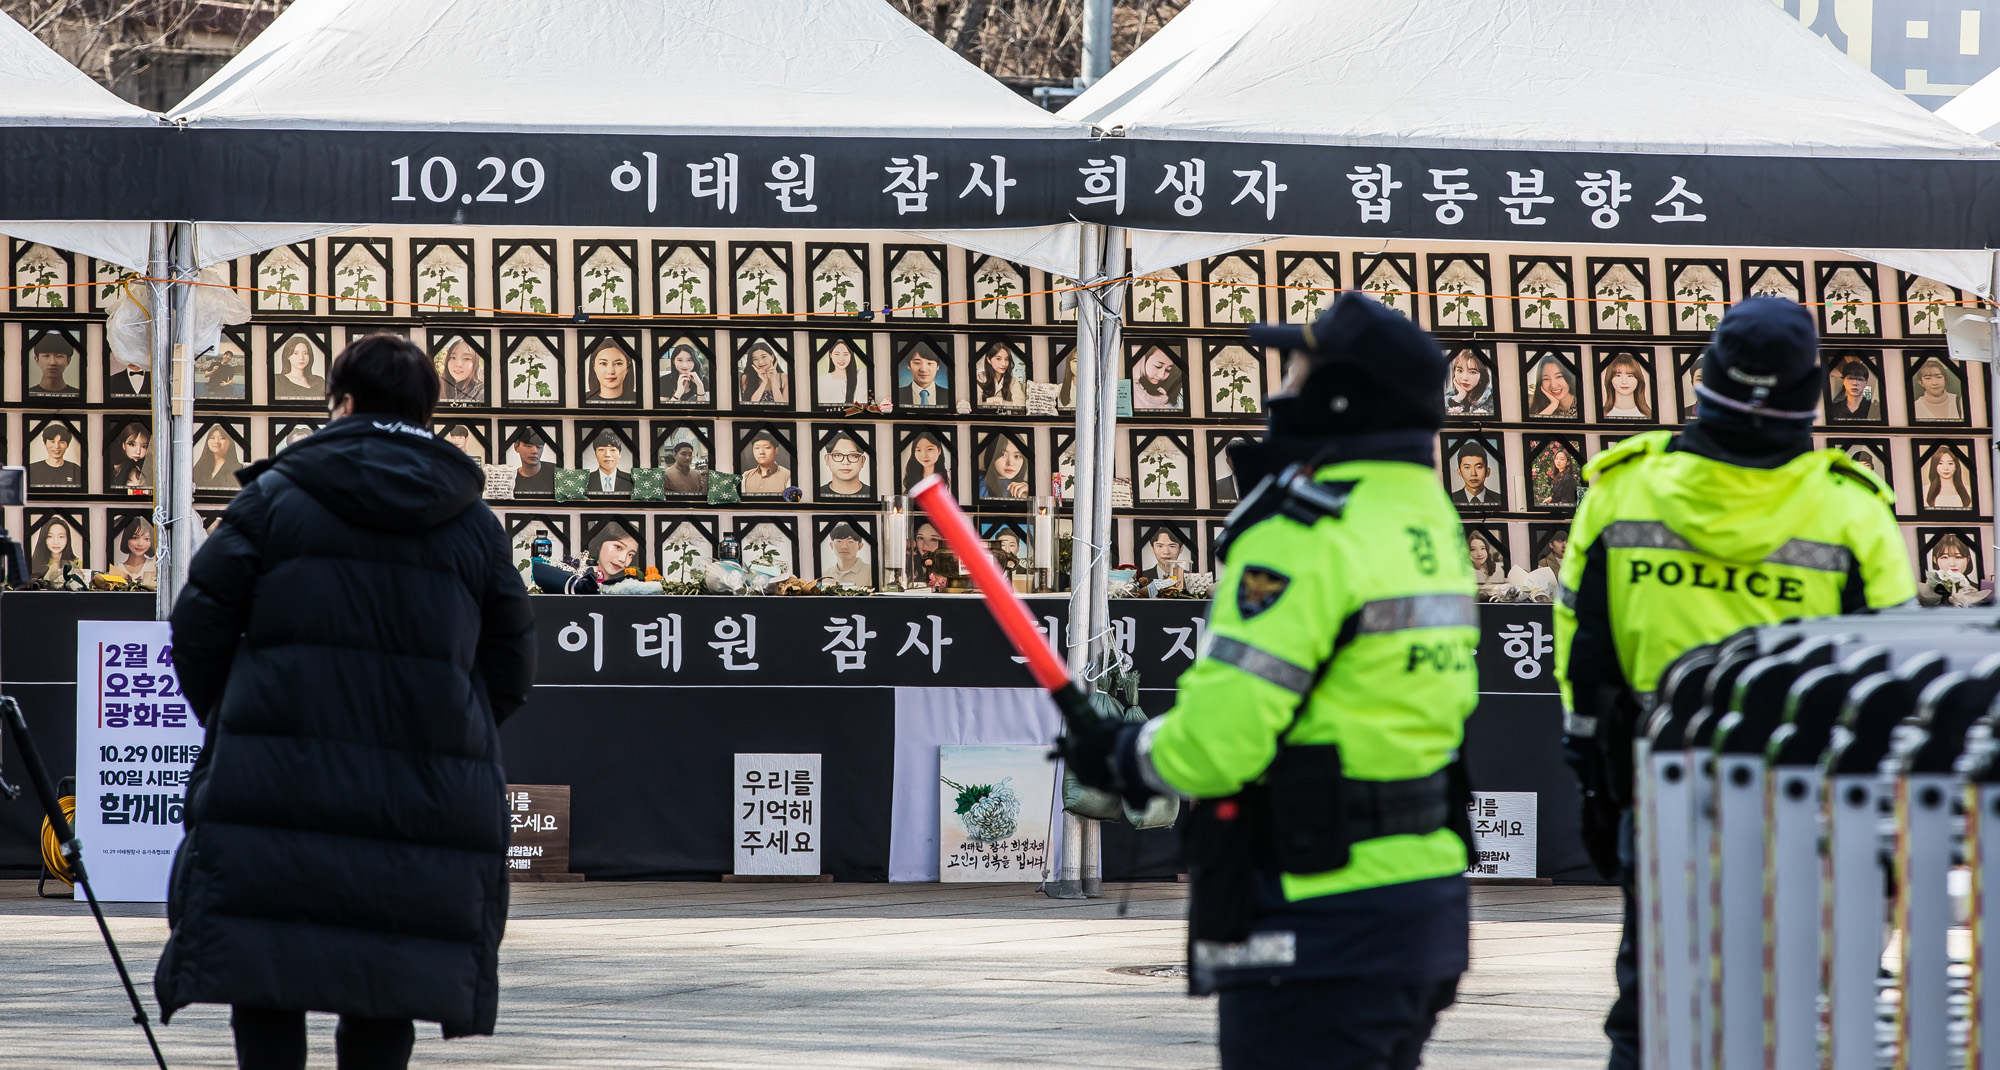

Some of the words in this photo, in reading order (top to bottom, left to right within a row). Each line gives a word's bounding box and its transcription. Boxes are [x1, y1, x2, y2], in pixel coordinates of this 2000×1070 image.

[391, 155, 546, 205] 10.29
[610, 151, 818, 215] 이태원
[882, 154, 1017, 216] 참사
[1076, 154, 1288, 221] 희생자
[1346, 162, 1707, 230] 합동분향소
[1629, 560, 1806, 602] POLICE
[105, 643, 148, 669] 2월
[558, 612, 760, 673] 이태원
[821, 613, 953, 675] 참사
[104, 672, 183, 698] 오후2
[104, 702, 188, 729] 광화문
[99, 745, 148, 763] 10.29
[99, 769, 143, 787] 100일
[742, 770, 814, 796] 우리를
[510, 813, 558, 834] 주세요
[742, 800, 812, 826] 기억해
[1475, 820, 1524, 838] 주세요
[740, 830, 815, 856] 주세요
[960, 841, 984, 853] 이태원
[989, 840, 1009, 853] 참사
[1010, 838, 1045, 854] 희생자의
[947, 852, 978, 870] 고인의
[981, 852, 1011, 872] 명복을
[1015, 852, 1046, 870] 빕니다
[1478, 863, 1498, 874] 처벌!
